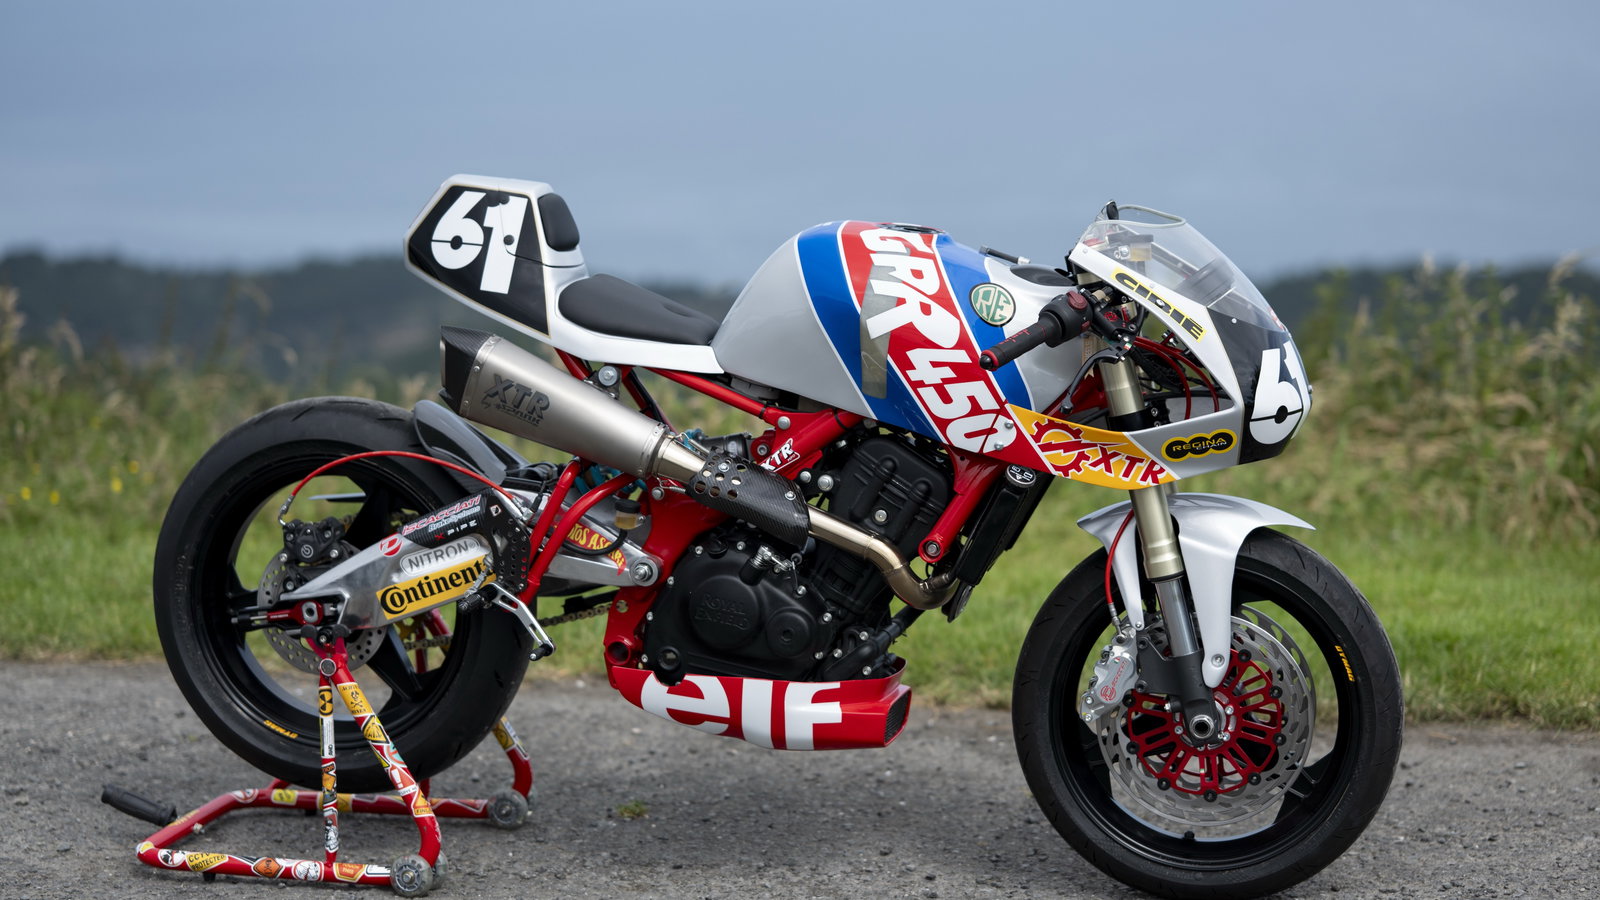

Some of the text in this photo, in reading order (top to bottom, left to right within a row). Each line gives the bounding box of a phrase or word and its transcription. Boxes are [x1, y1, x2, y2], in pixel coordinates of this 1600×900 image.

[431, 190, 528, 294] 61
[484, 374, 549, 419] XTR
[1249, 341, 1311, 445] 61
[1087, 445, 1167, 486] XTR
[1173, 438, 1227, 451] REGINA
[408, 541, 469, 572] NITRON
[380, 560, 494, 615] Continent
[641, 671, 842, 750] elf
